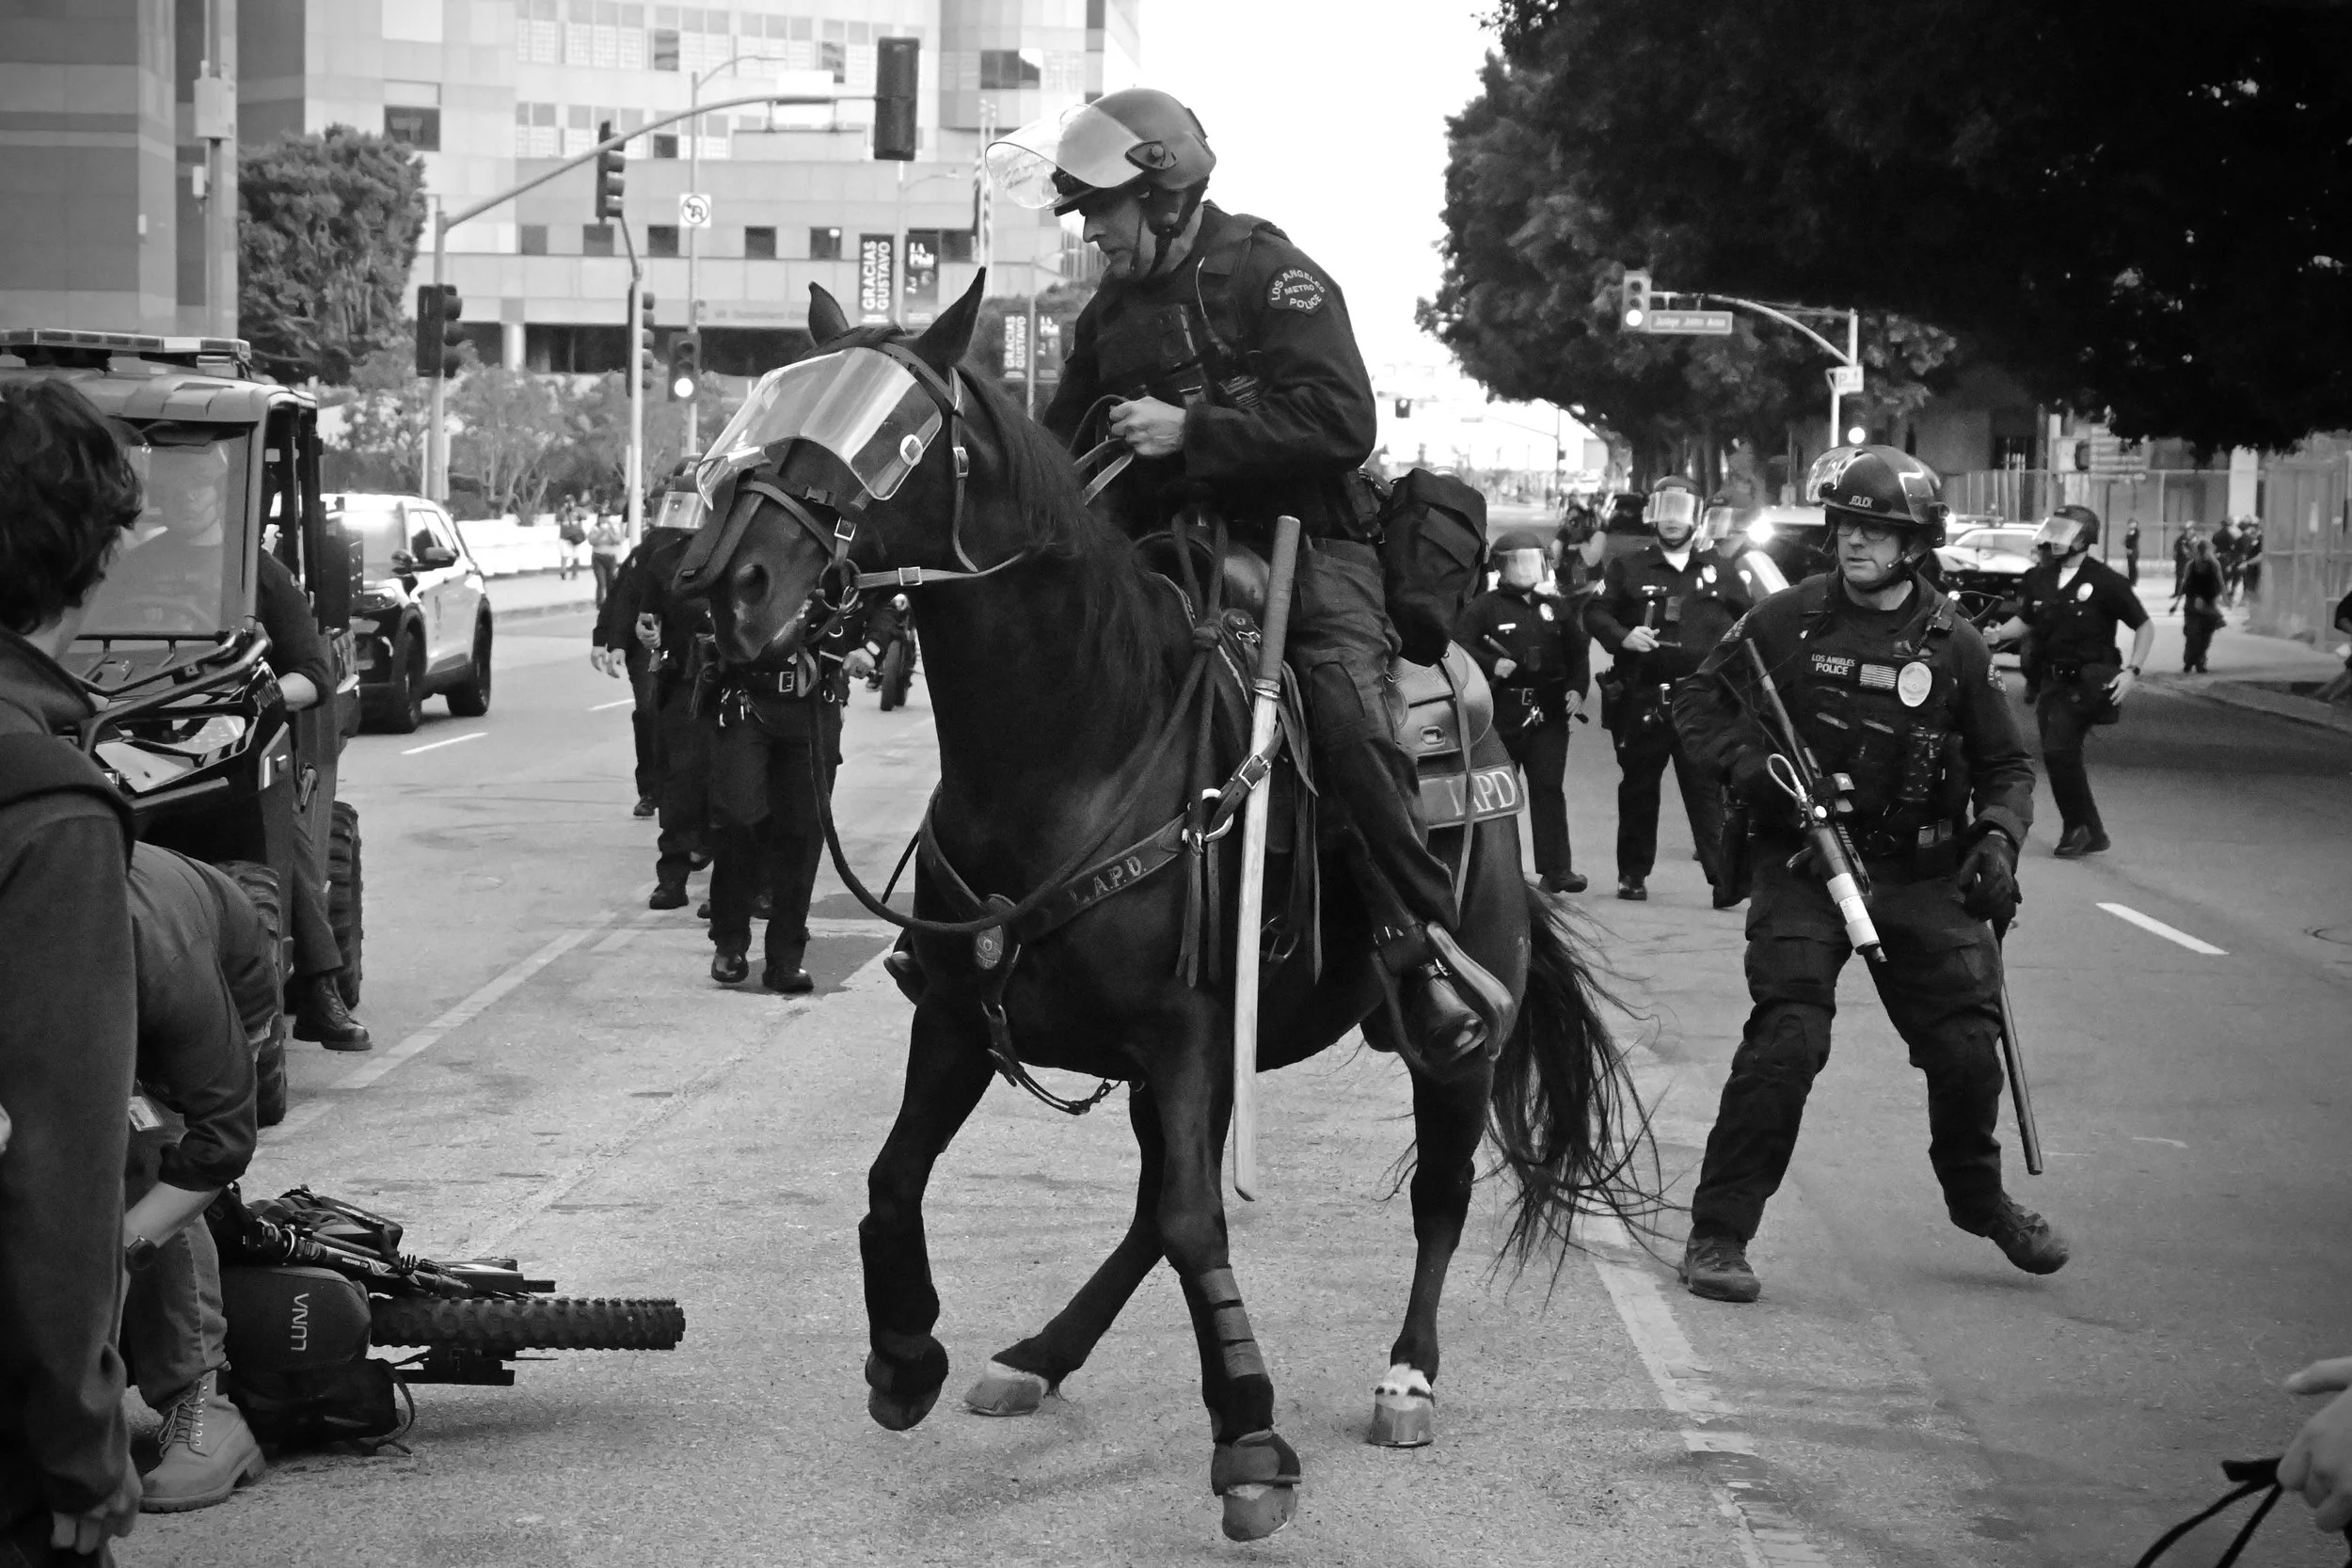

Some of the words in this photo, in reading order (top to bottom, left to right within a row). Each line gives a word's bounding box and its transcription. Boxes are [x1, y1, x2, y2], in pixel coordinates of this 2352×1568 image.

[909, 242, 927, 254] LA
[862, 241, 877, 310] GRACIAS
[876, 241, 891, 310] GUSTAVO
[1271, 279, 1284, 301] LOS
[1281, 269, 1326, 293] ANGELES
[1283, 284, 1315, 295] METRO
[1289, 293, 1322, 309] POLICE
[1004, 315, 1016, 369] GRACIAS
[1015, 315, 1026, 369] GUSTAVO
[1811, 654, 1826, 663] LOS
[1826, 656, 1855, 667] ANGELES
[1816, 662, 1849, 675] POLICE
[291, 1292, 310, 1352] LUNA
